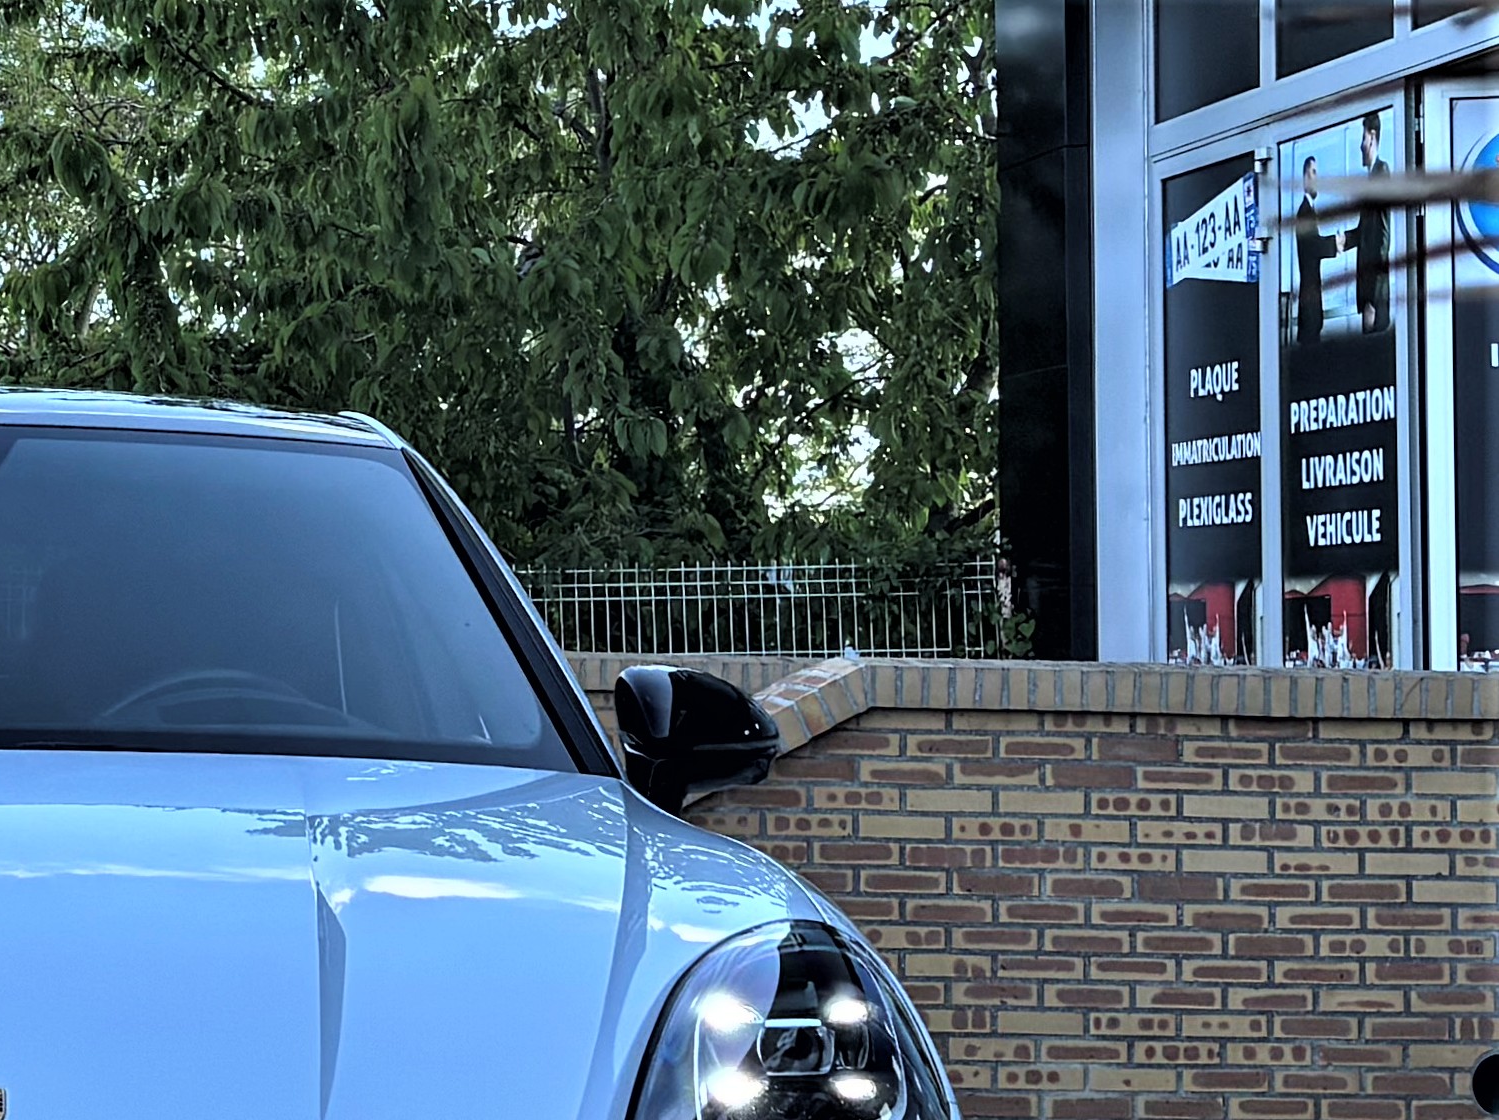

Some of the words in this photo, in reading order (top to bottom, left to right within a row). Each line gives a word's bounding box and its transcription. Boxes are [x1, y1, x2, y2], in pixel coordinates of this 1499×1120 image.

[1190, 361, 1239, 401] PLAQUE
[1290, 385, 1395, 434] PREPARATION
[1172, 431, 1261, 466] IMMATRICULATION
[1301, 447, 1384, 489] LIVRAISON
[1178, 492, 1252, 527] PLEXIGLASS
[1306, 508, 1381, 547] VEHICULE
